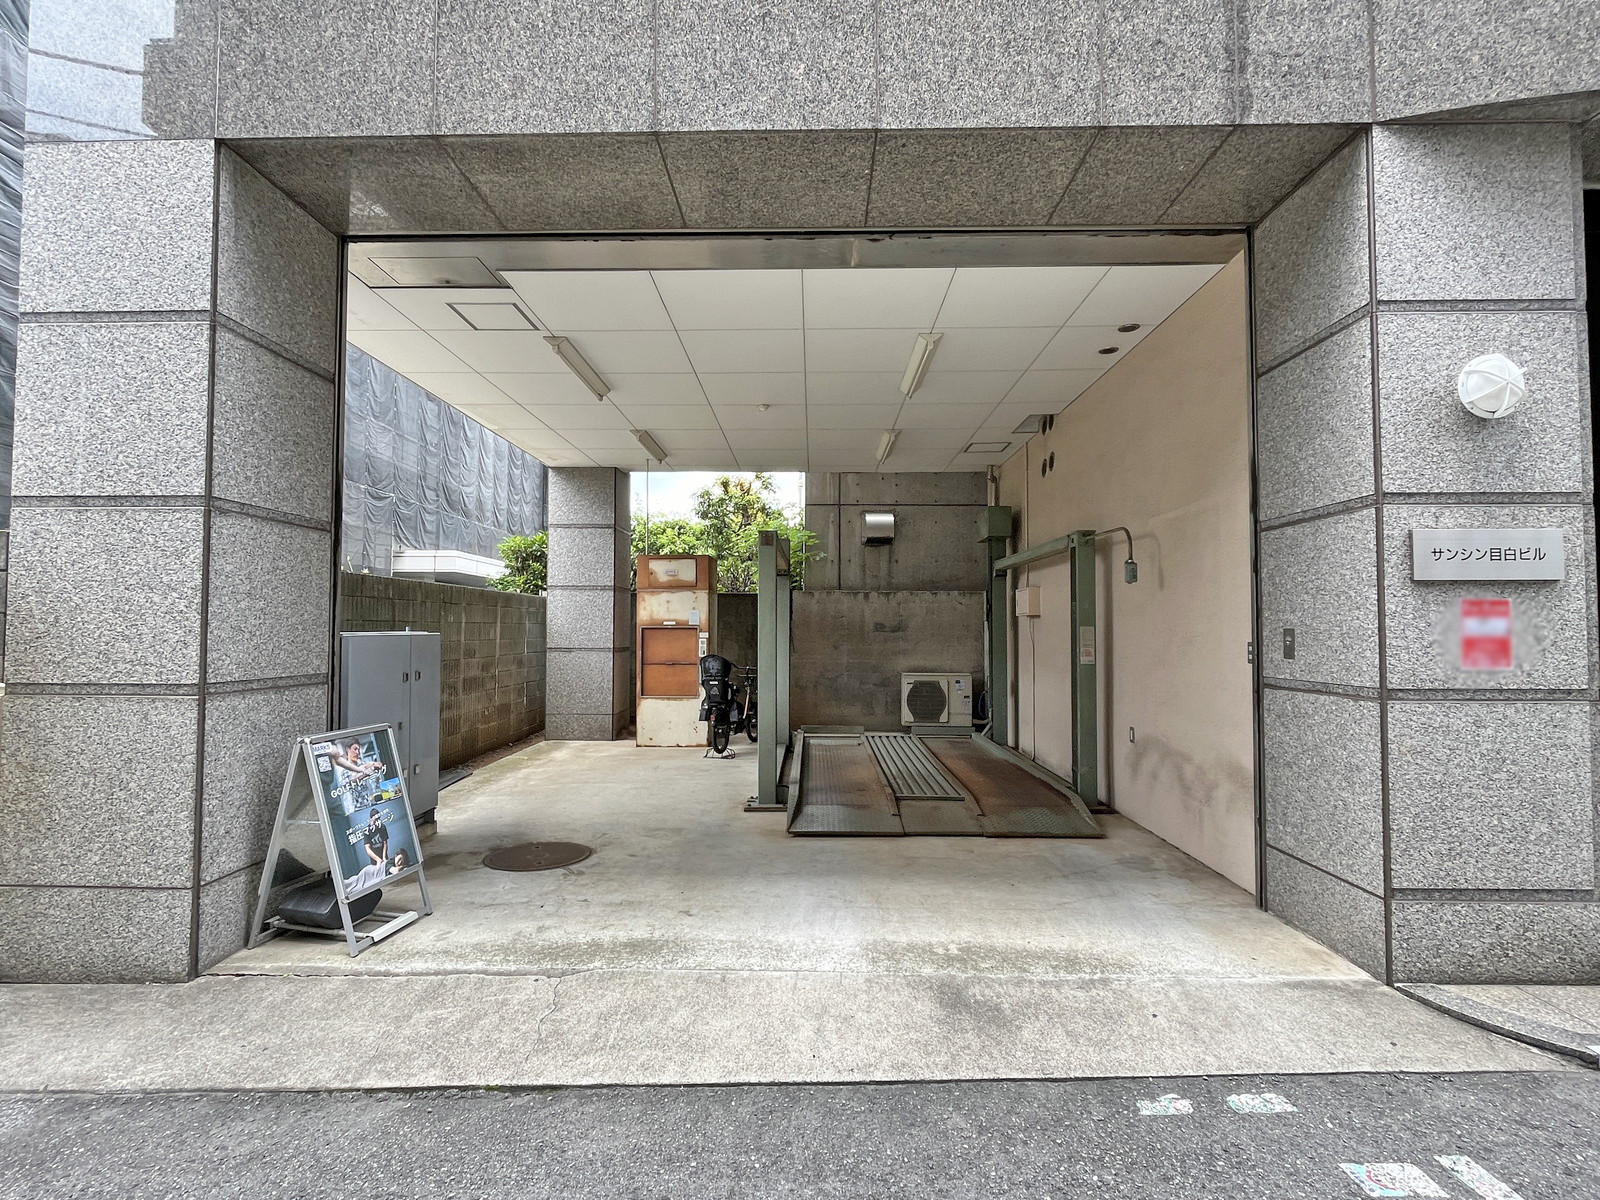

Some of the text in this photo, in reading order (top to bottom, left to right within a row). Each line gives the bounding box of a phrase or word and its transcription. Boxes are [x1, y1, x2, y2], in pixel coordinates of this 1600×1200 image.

[1431, 547, 1546, 562] サンシン目白ビル
[330, 764, 387, 798] GOLFトレーニング
[348, 811, 394, 845] 指圧マッサージ
